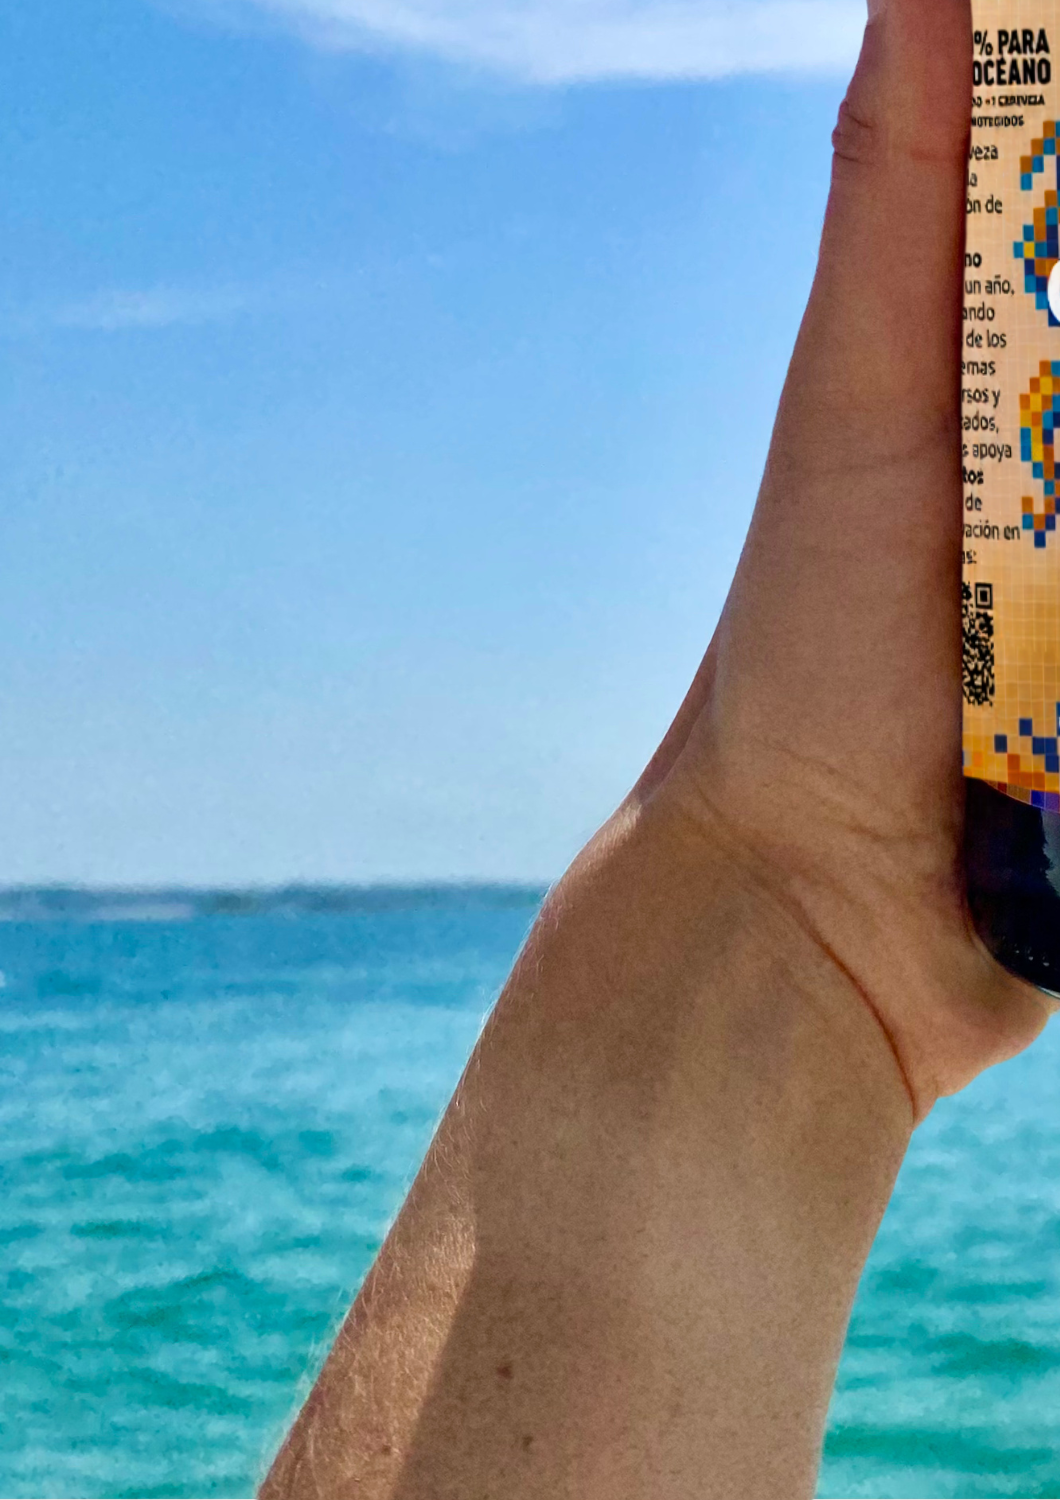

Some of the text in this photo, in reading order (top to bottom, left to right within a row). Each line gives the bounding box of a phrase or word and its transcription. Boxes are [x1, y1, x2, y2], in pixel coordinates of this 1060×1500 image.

[997, 27, 1050, 55] PARA
[985, 194, 1003, 214] de
[985, 274, 1015, 297] año,
[966, 329, 1007, 348] de los
[991, 389, 1001, 409] y
[972, 443, 1012, 463] apoya
[965, 493, 982, 512] de
[1003, 525, 1021, 541] en
